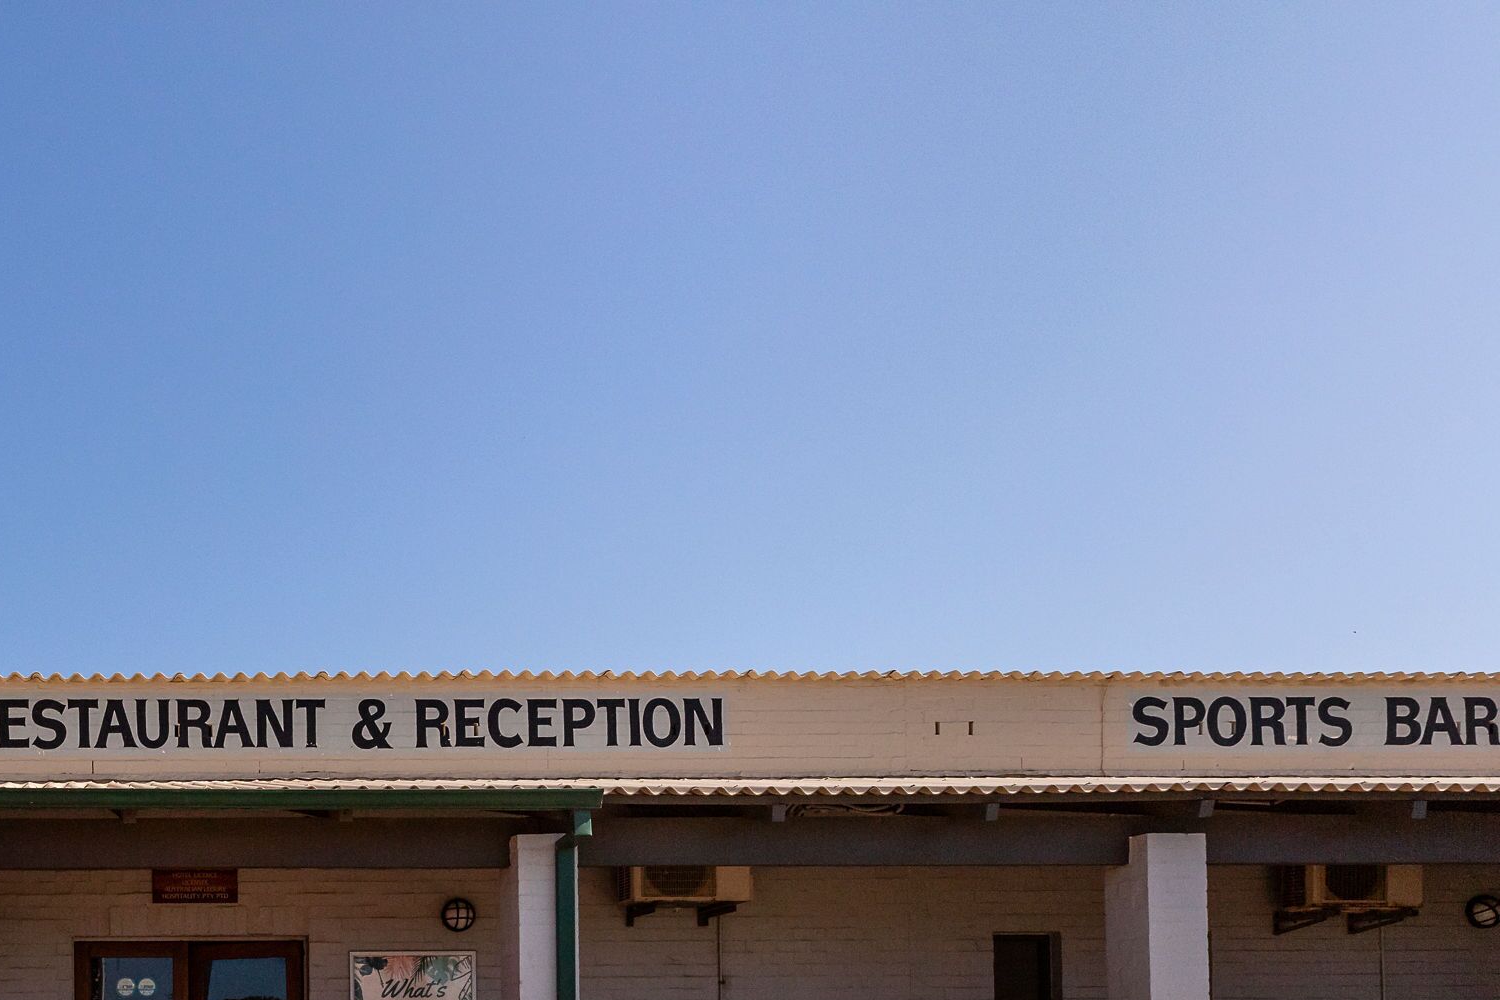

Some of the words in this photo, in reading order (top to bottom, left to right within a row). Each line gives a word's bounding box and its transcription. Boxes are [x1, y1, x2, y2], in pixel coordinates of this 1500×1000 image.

[351, 698, 394, 749] &
[415, 697, 724, 749] RECEPTION
[1132, 696, 1353, 747] SPORTS
[1384, 696, 1500, 746] BAR
[381, 978, 448, 998] What's
